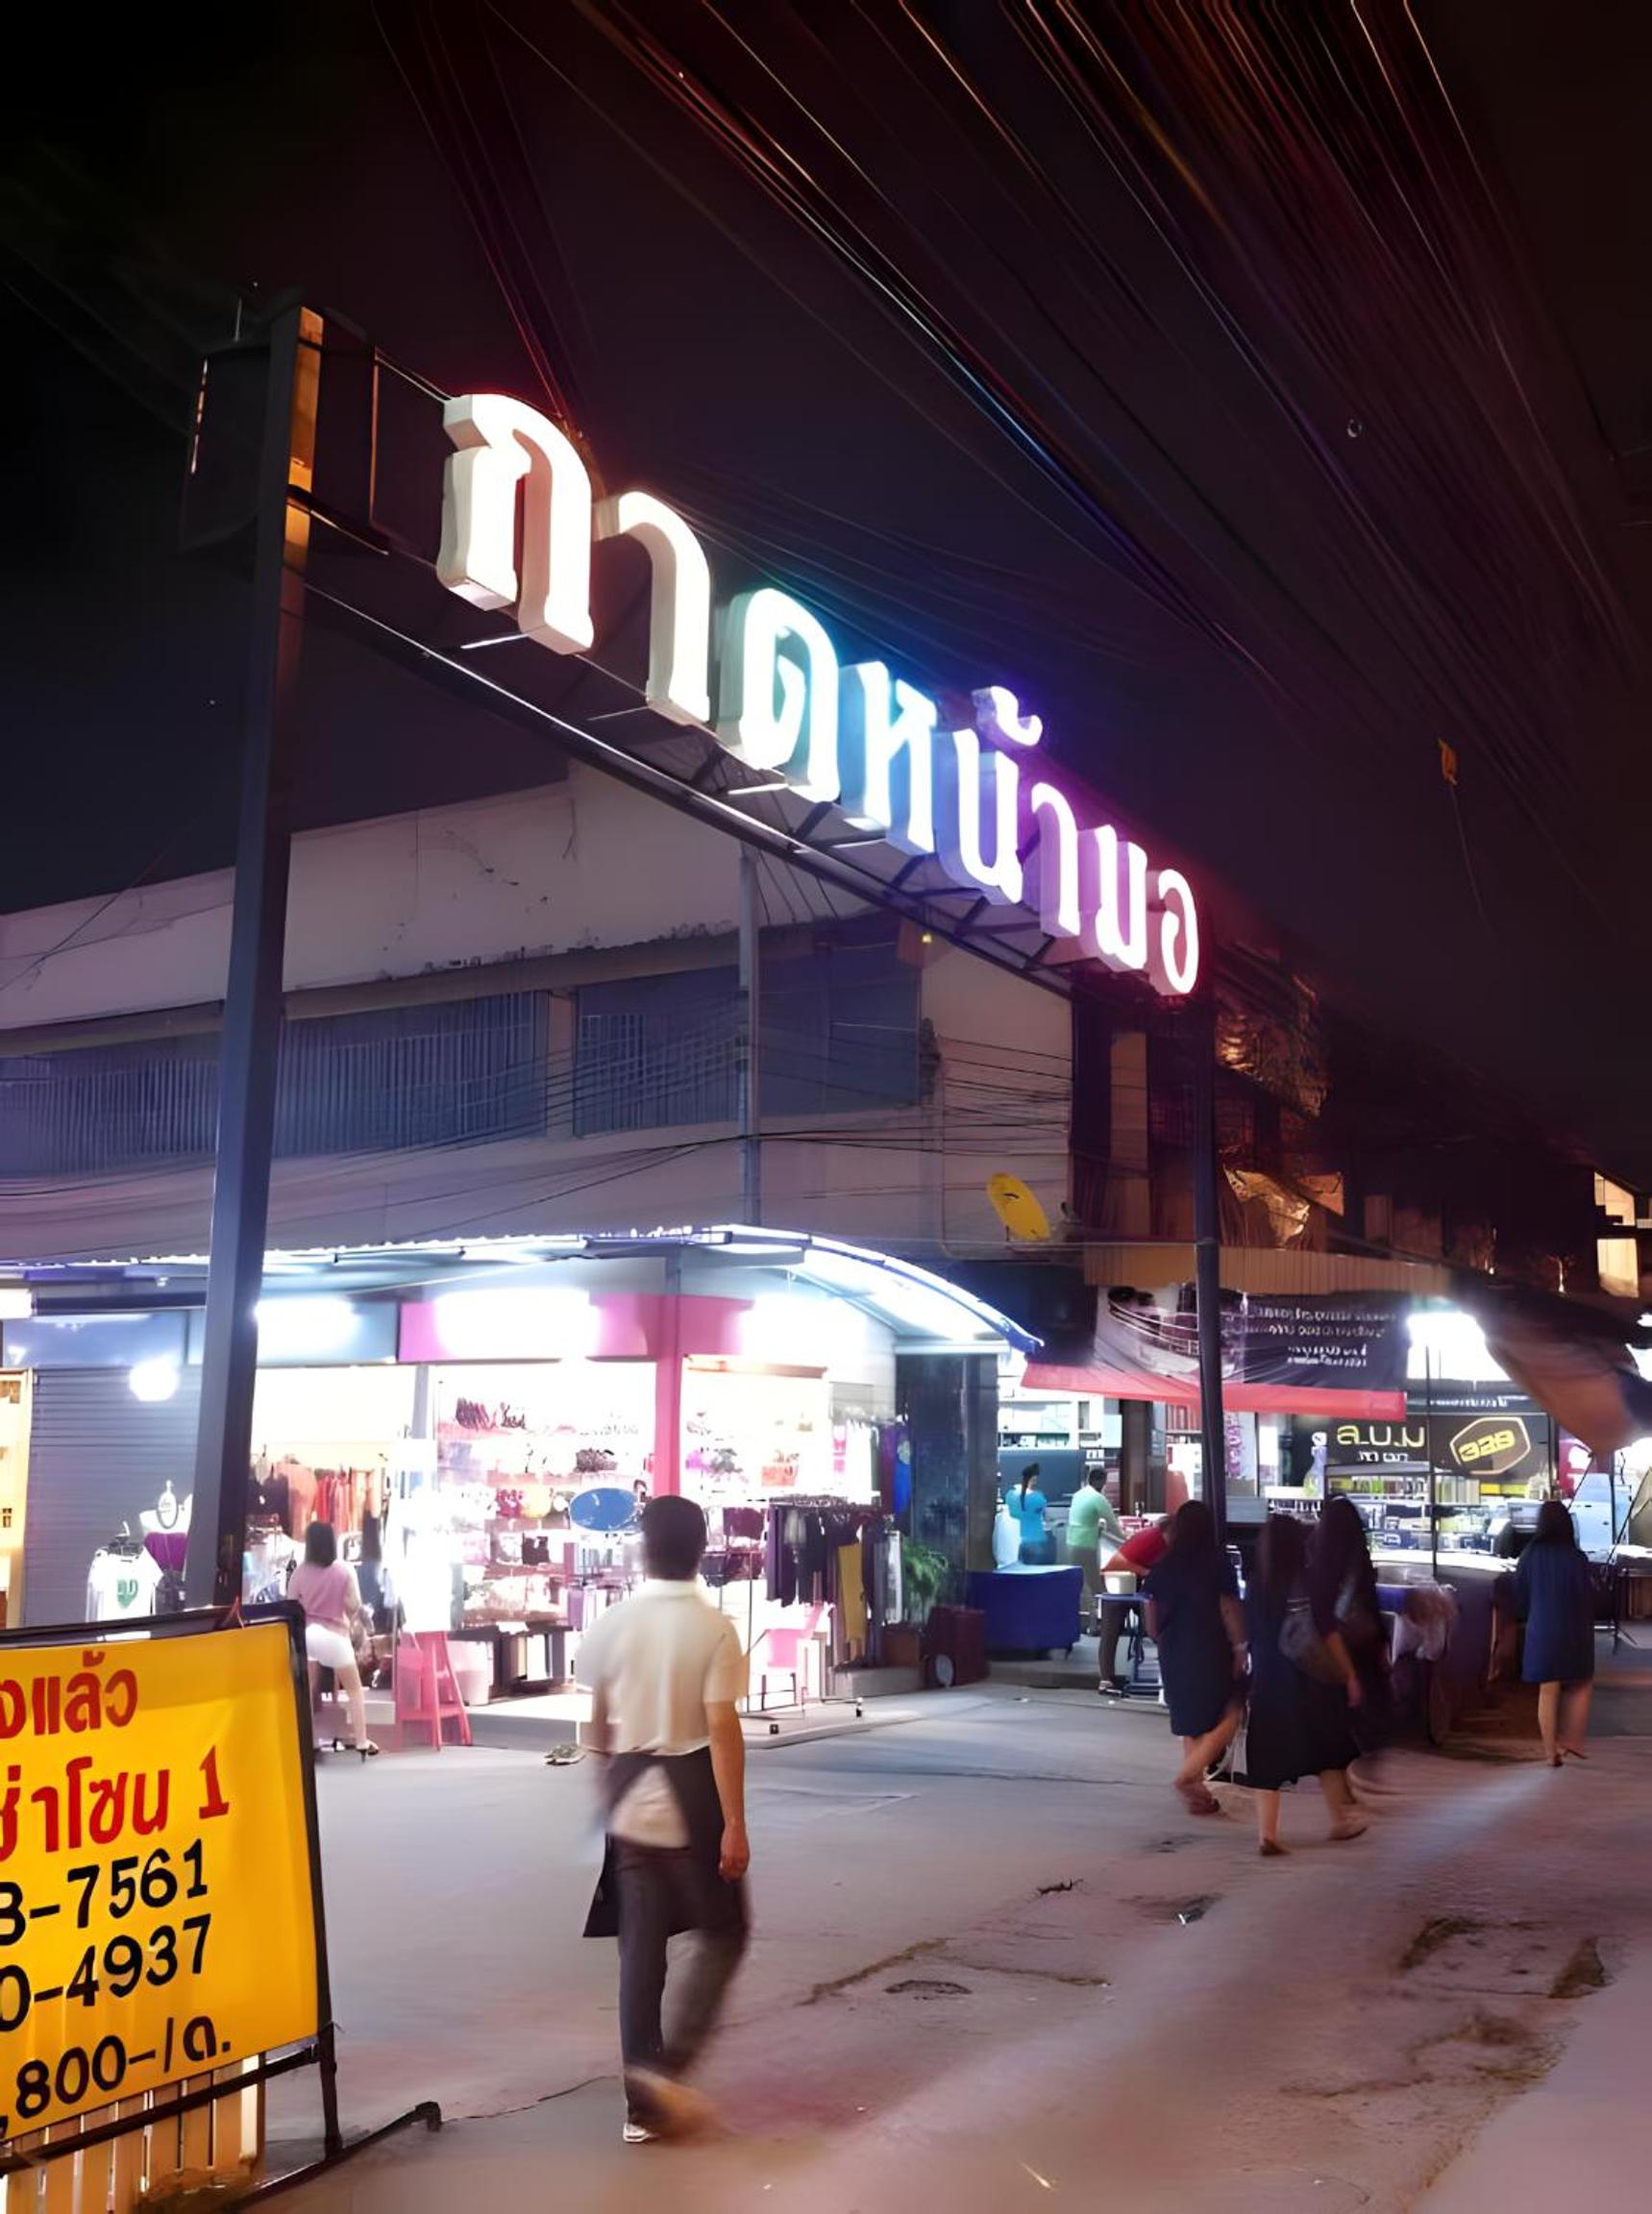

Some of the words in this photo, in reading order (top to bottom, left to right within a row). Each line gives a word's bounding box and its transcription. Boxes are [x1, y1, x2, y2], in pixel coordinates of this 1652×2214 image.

[436, 393, 1199, 996] กาดหน้ามอ
[199, 1746, 230, 1820] 1
